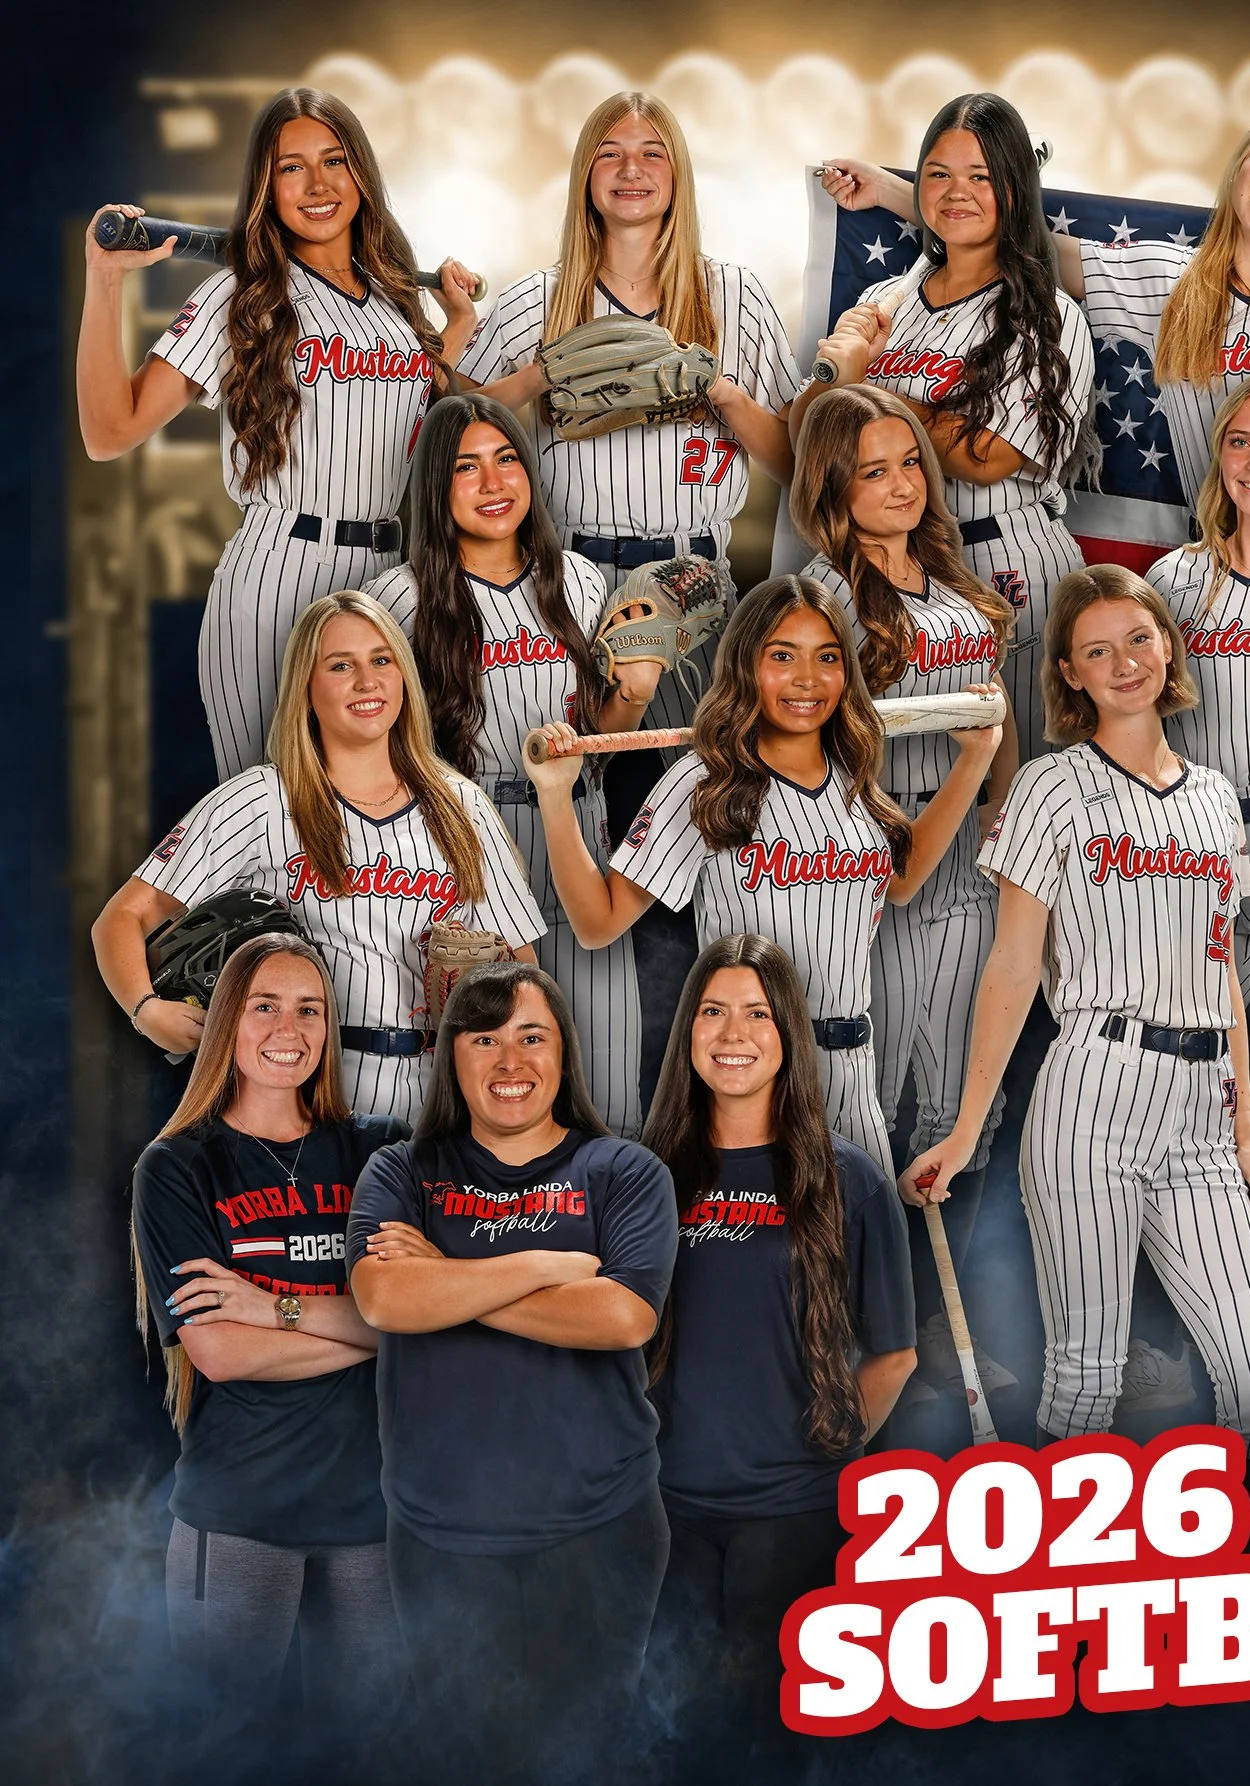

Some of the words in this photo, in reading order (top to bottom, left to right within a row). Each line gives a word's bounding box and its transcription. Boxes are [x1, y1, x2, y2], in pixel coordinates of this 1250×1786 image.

[680, 436, 741, 487] 27
[991, 570, 1028, 609] YL
[1172, 583, 1199, 595] LEGENDS
[616, 633, 661, 650] Wilson
[1011, 636, 1038, 653] LEGENDS
[1085, 792, 1110, 805] LEGENDS
[463, 1184, 520, 1203] YORBA
[523, 1181, 573, 1196] LINDA
[729, 1190, 777, 1206] LINDA
[215, 1185, 308, 1228] YORBA
[443, 1190, 585, 1220] MUSTANG
[470, 1208, 557, 1243] softball
[288, 1233, 346, 1261] 2026
